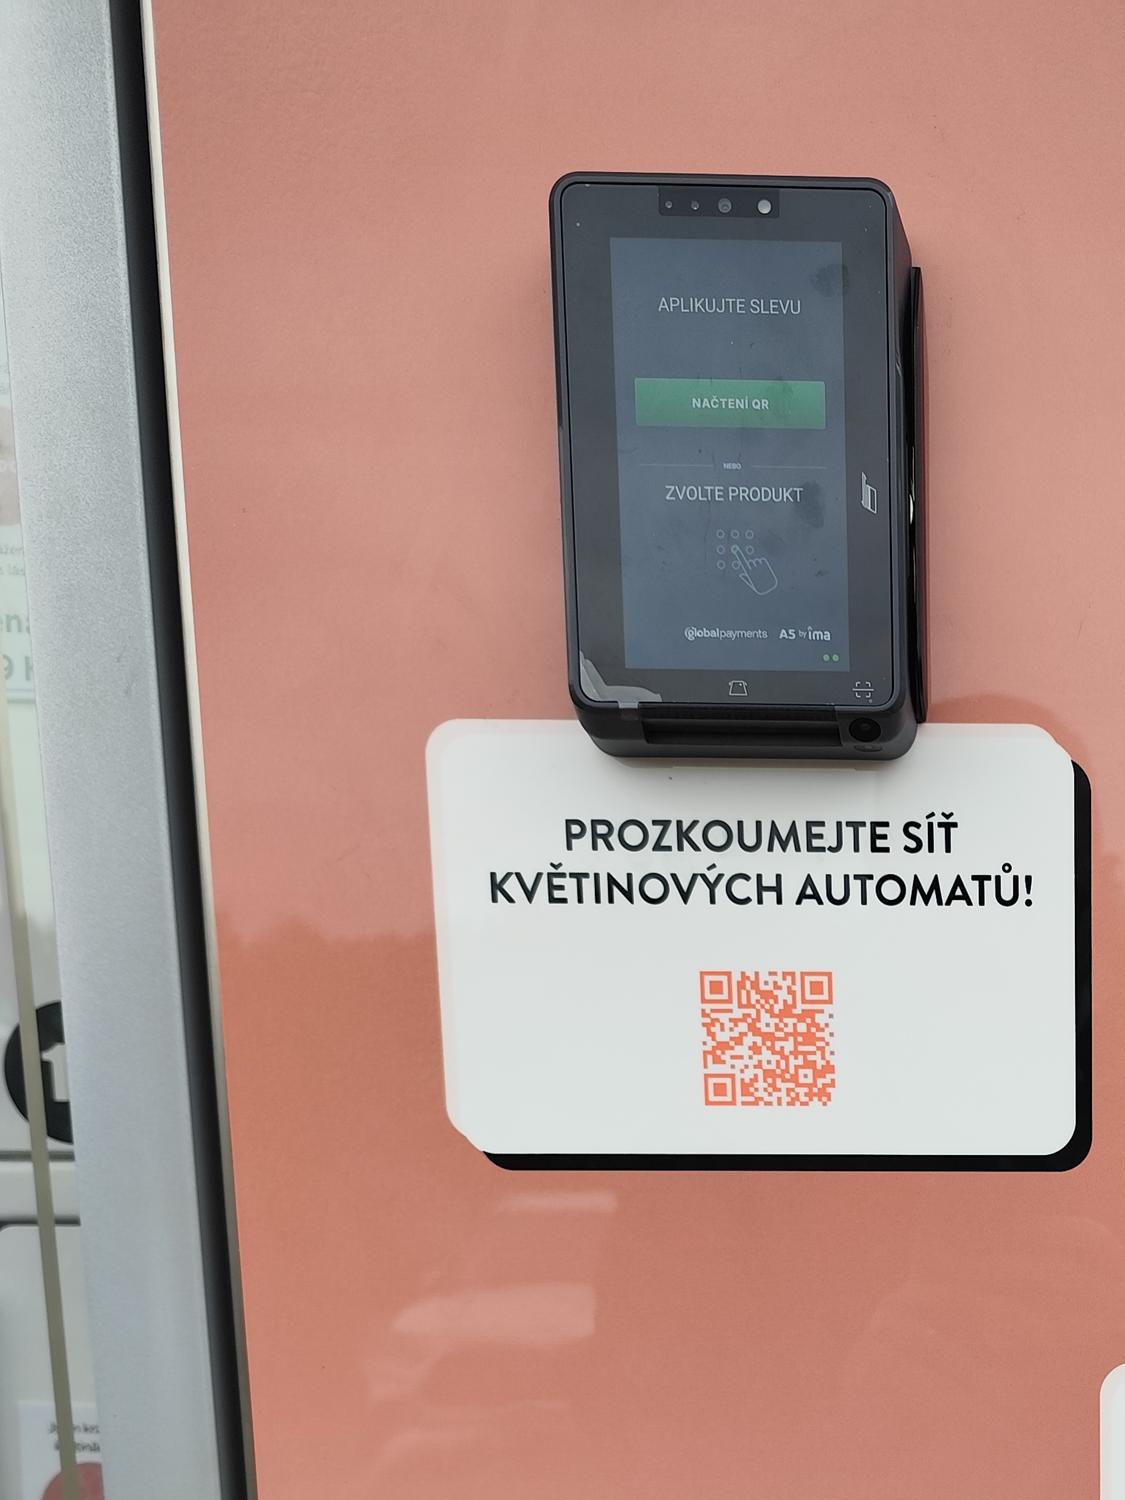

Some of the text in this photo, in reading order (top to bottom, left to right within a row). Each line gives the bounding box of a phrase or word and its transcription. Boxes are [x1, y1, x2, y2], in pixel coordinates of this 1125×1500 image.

[658, 296, 801, 316] APLIKUJTE SLEVU
[692, 394, 770, 413] NAČTENÍ QR
[723, 462, 742, 471] NEBO
[665, 485, 804, 504] ZVOLTE PRODUKT
[564, 811, 959, 855] PROZKOUMEJTE SÍŤ
[489, 862, 1034, 907] KVĚTINOVÝCH AUTOMATŮ!
